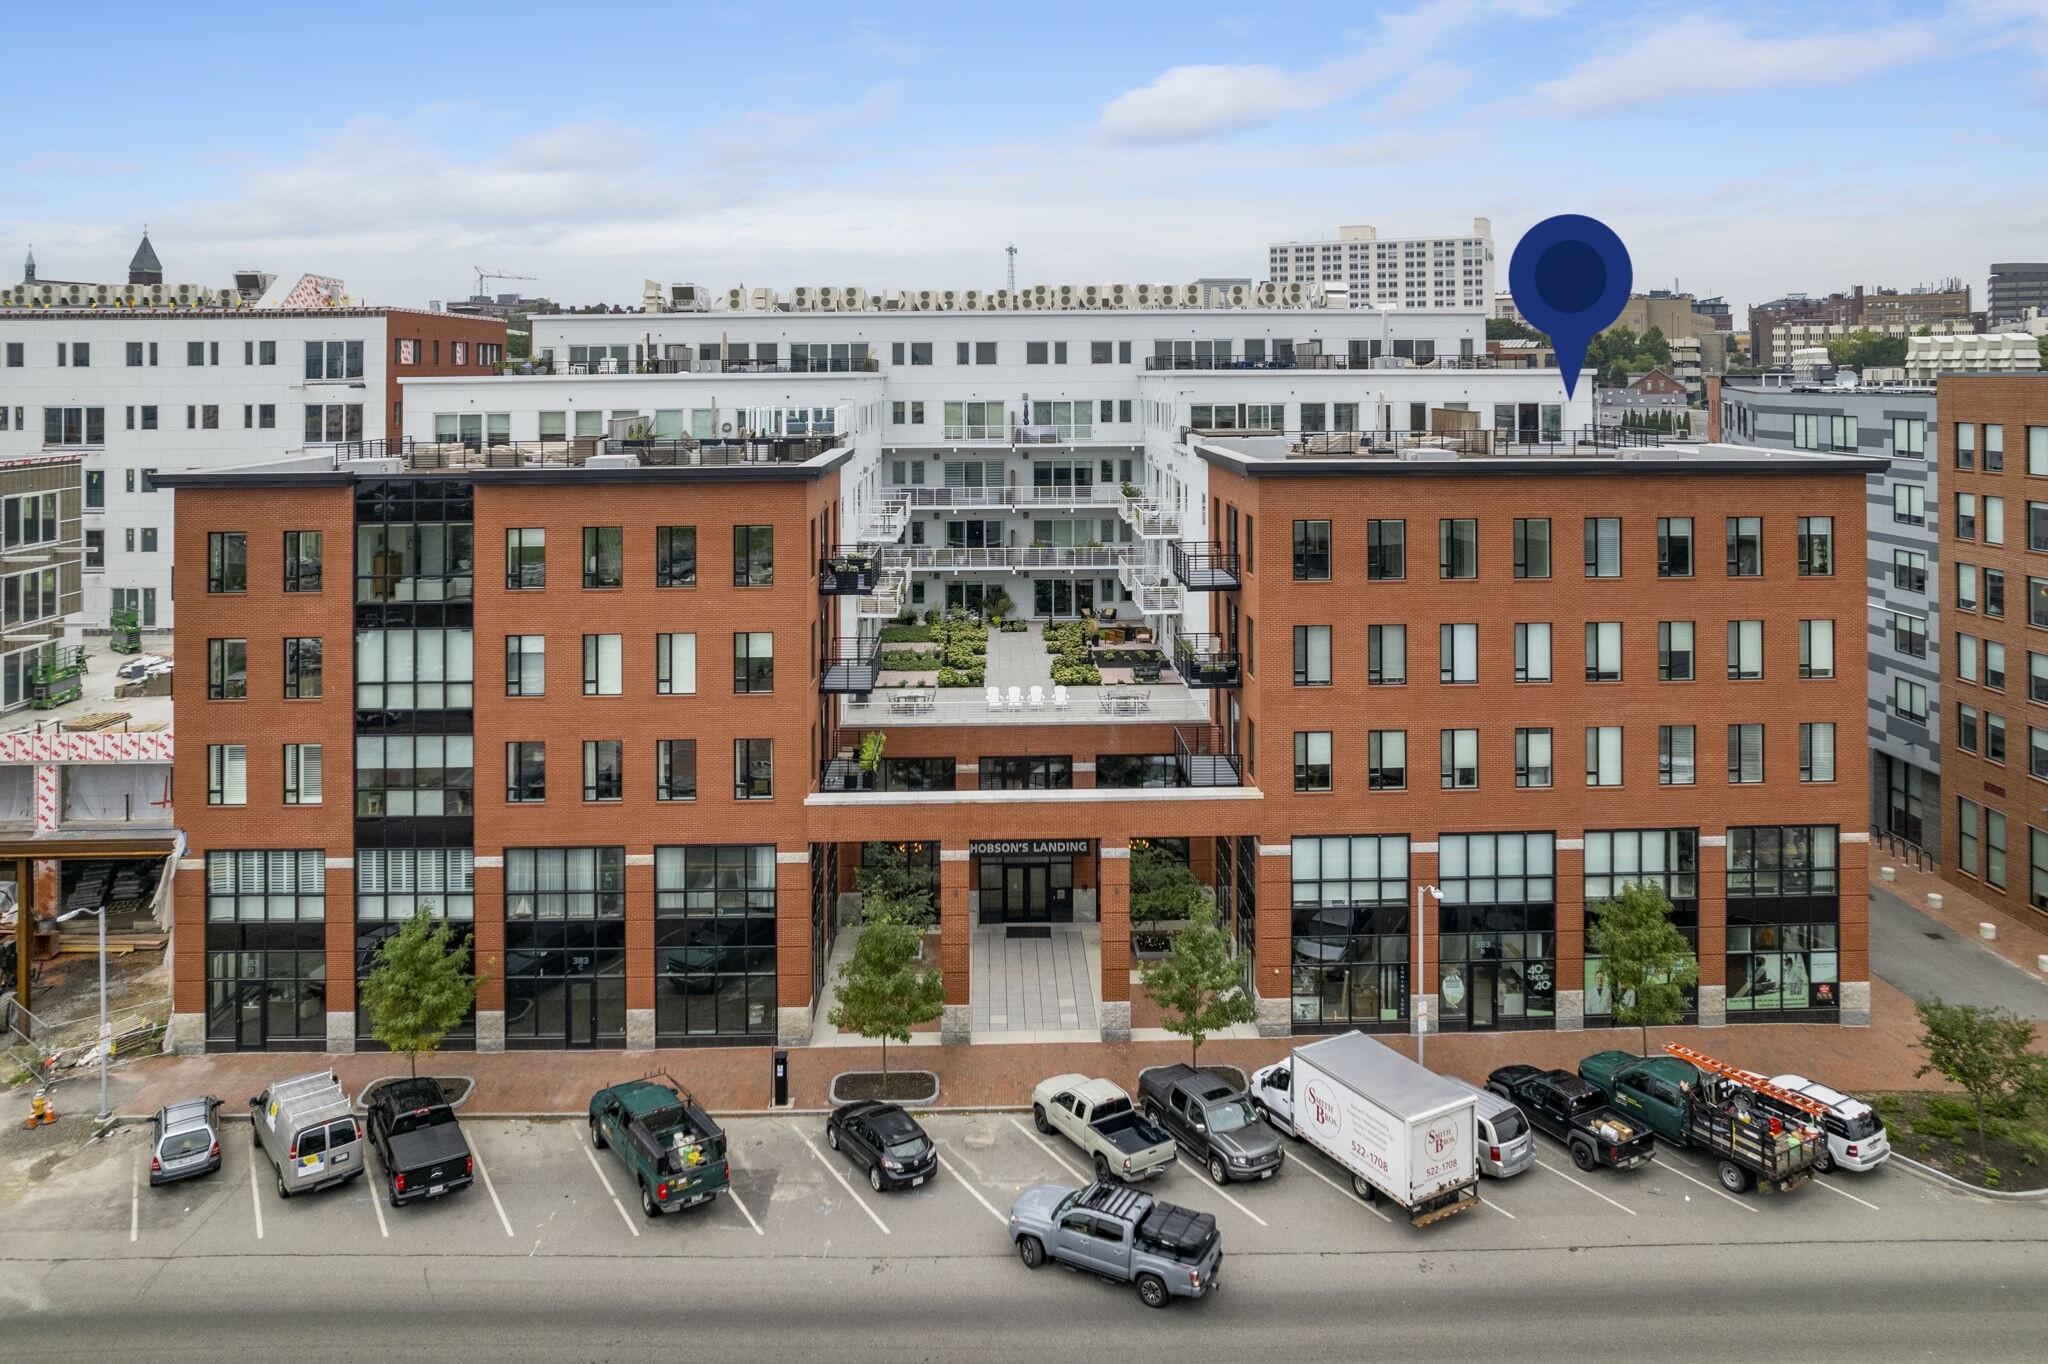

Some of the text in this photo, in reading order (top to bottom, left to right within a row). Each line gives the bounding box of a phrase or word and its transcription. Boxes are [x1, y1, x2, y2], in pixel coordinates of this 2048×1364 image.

[970, 841, 1088, 854] HOBSON'S LANDING
[572, 956, 590, 965] 383
[1527, 964, 1544, 974] 40
[1534, 980, 1552, 991] 40
[1351, 1140, 1389, 1173] 522-1708
[1426, 1159, 1458, 1177] 522-1708
